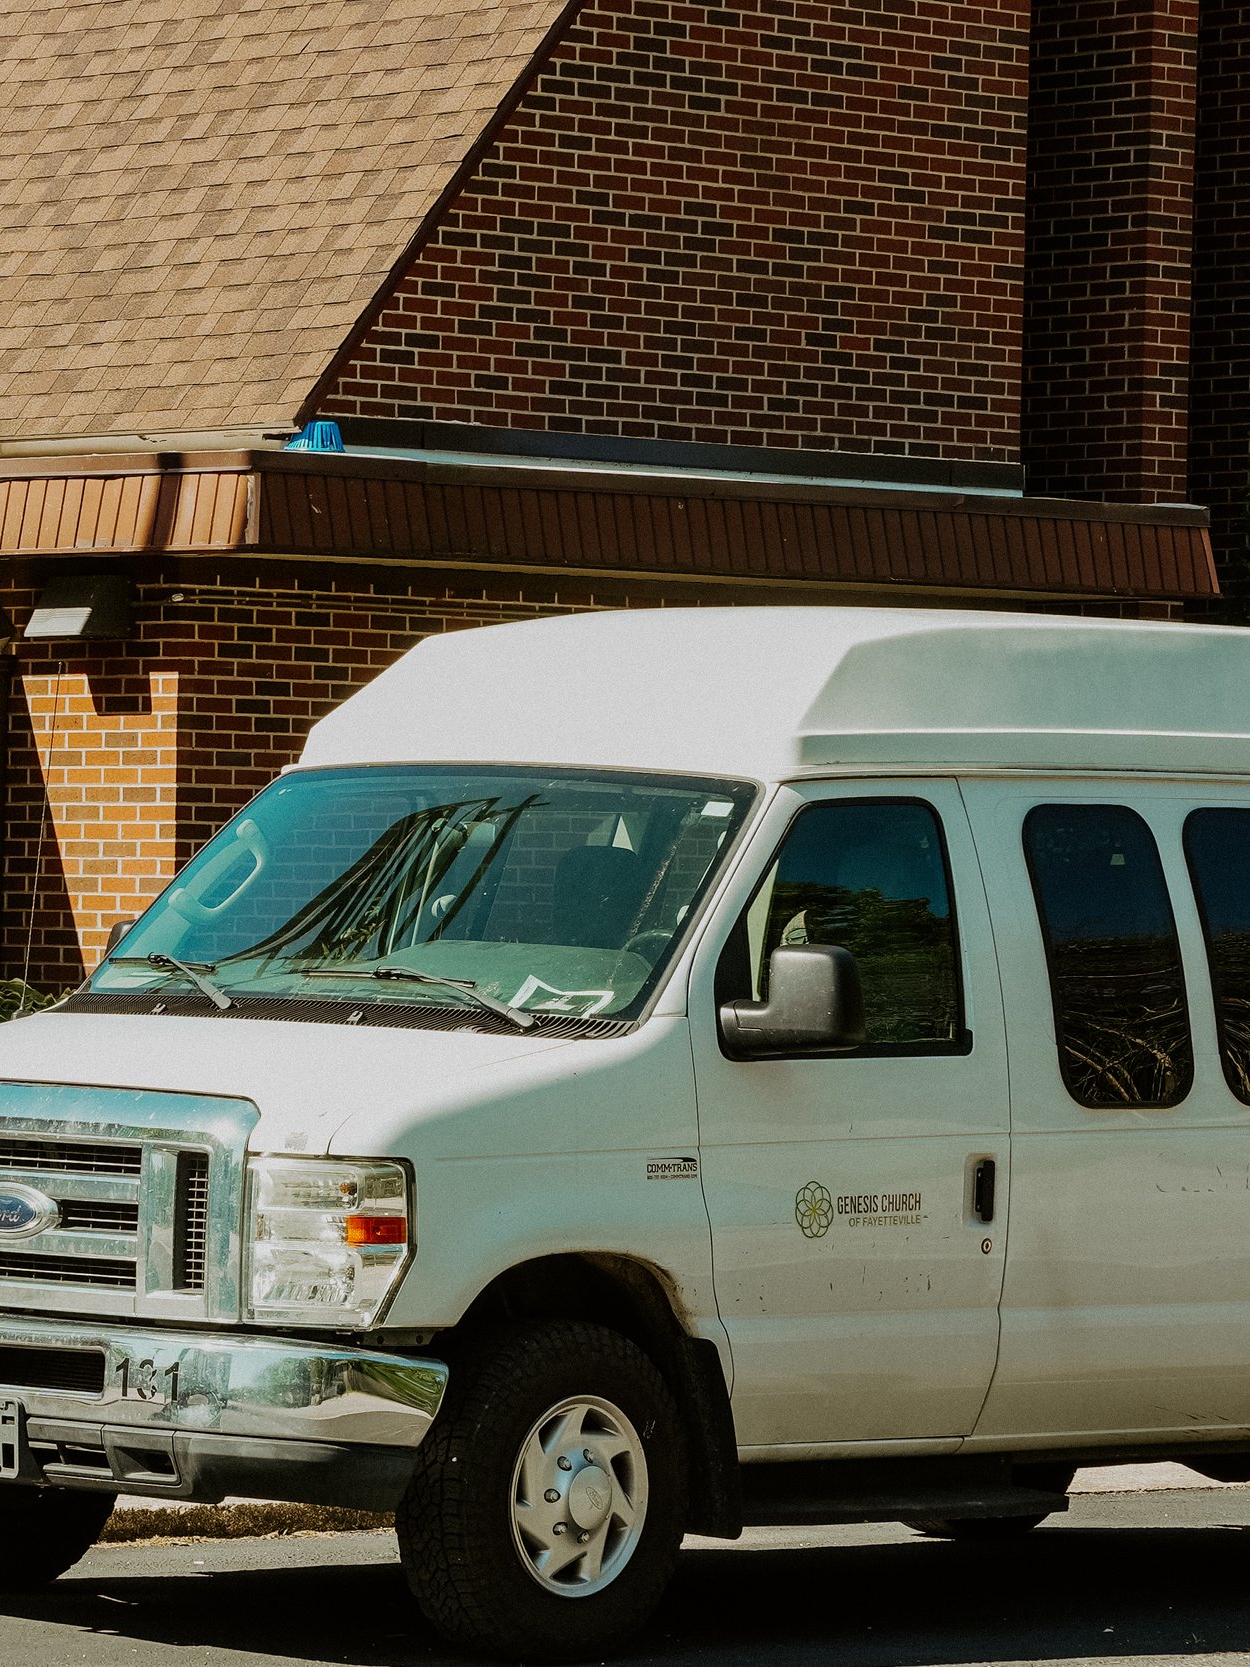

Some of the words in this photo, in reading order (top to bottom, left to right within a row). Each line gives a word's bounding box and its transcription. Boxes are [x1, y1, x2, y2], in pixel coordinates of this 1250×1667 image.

[837, 1194, 879, 1215] GENESIS
[881, 1192, 922, 1213] CHURCH
[848, 1217, 860, 1228] OF
[862, 1214, 922, 1227] FAYETTEVILLE
[115, 1358, 180, 1402] 131
